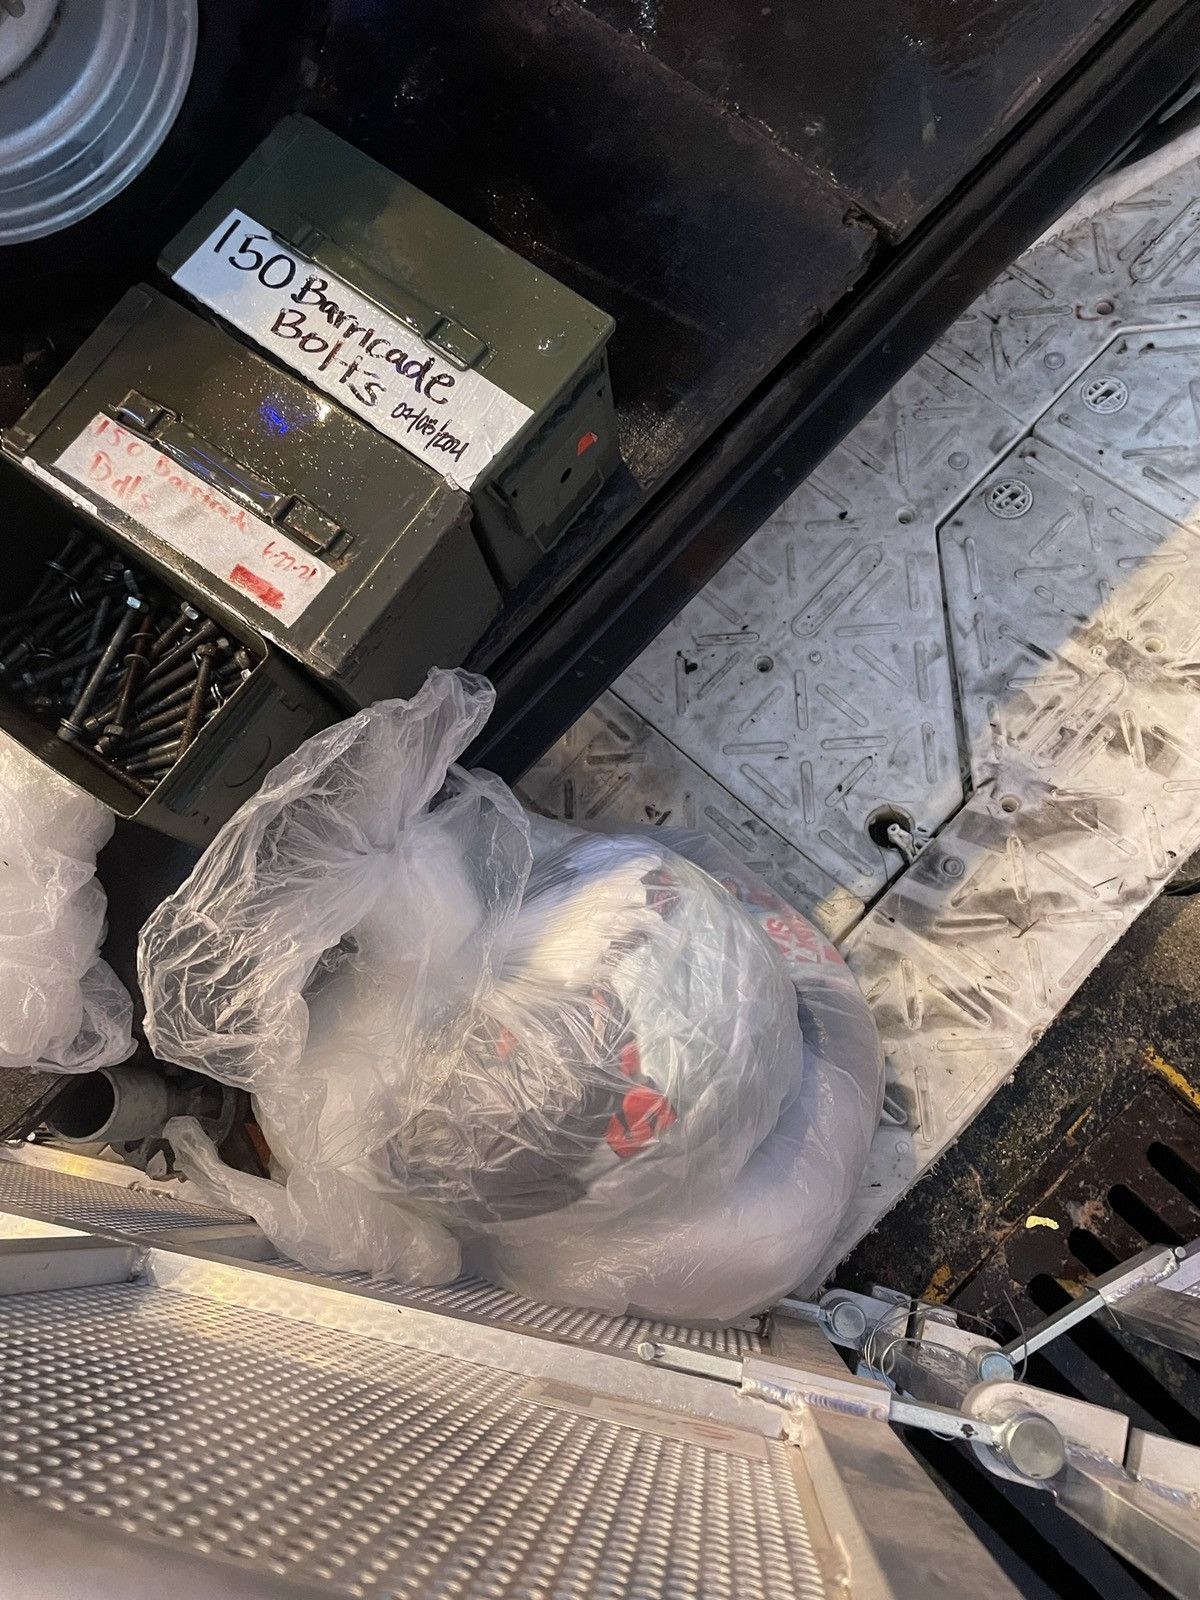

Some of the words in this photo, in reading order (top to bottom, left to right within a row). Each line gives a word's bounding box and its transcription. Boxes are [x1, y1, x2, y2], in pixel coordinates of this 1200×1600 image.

[213, 218, 296, 289] 150
[290, 273, 456, 405] Barricade
[270, 307, 387, 406] Bolts
[96, 419, 145, 457] 150
